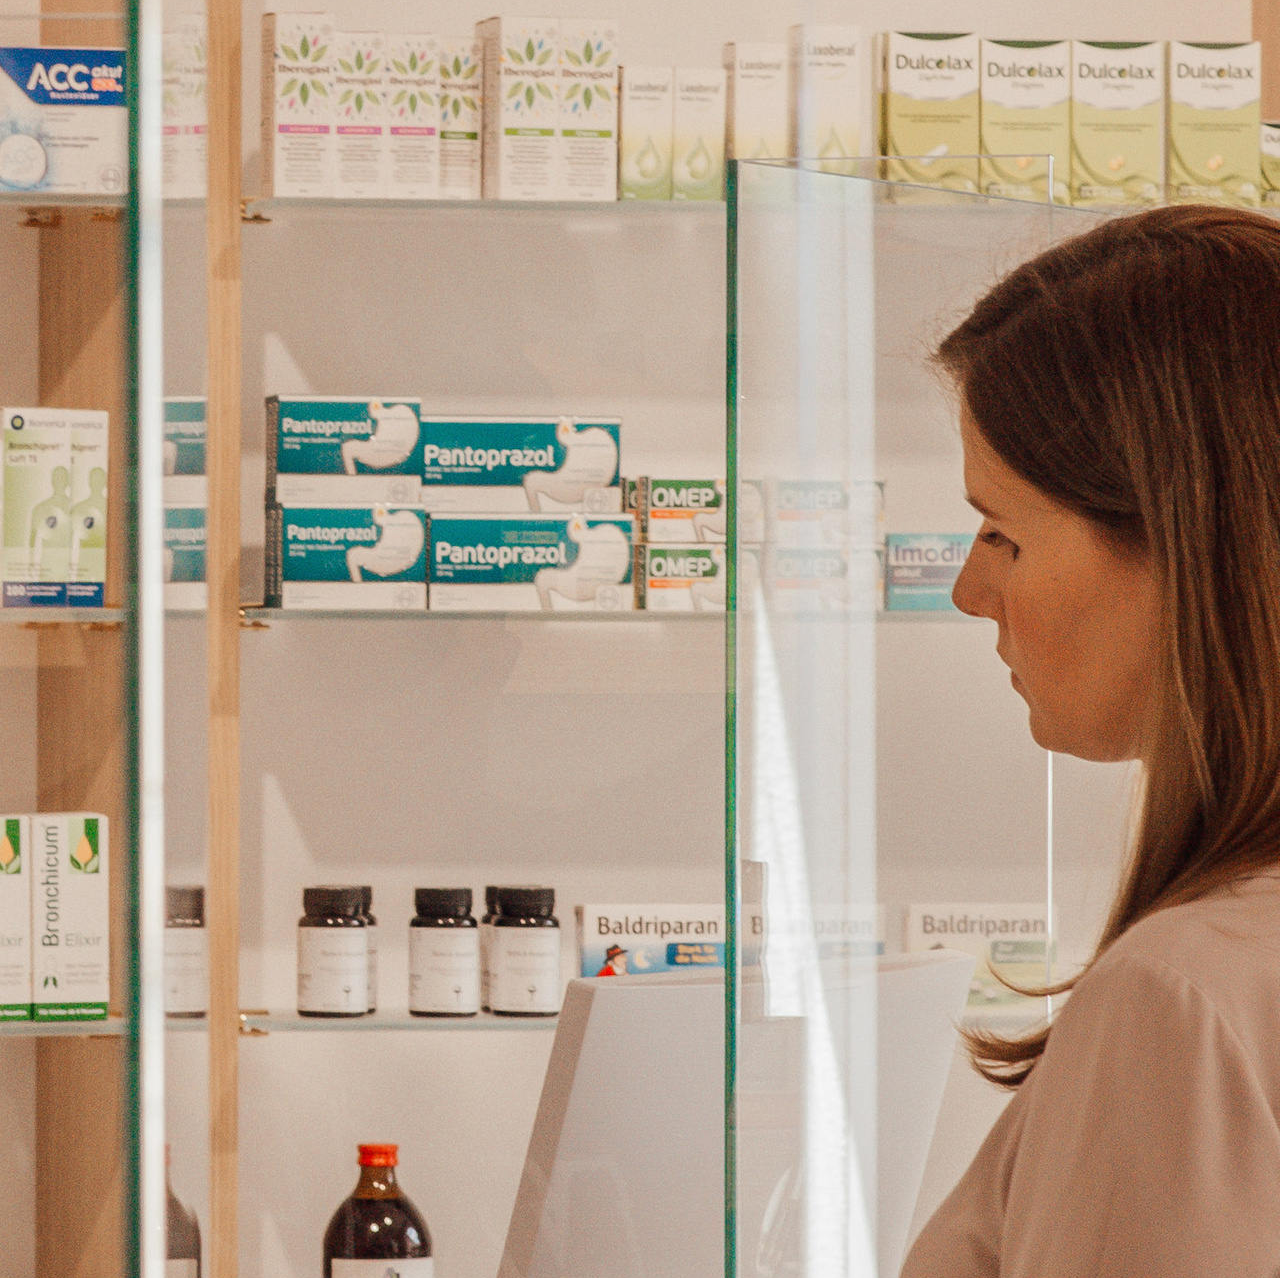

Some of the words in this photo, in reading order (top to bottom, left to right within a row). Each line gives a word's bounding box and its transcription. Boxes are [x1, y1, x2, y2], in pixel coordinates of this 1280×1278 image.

[278, 64, 330, 74] Iberogast
[895, 54, 974, 70] Dulcolax
[987, 62, 1064, 78] Dulcolax
[1078, 63, 1155, 79] Dulcolax
[1177, 63, 1254, 79] Dulcolax
[27, 64, 89, 92] ACC
[91, 65, 123, 79] akut
[282, 417, 373, 436] Pantoprazol
[424, 444, 555, 471] Pantoprazol
[652, 487, 715, 508] OMEP
[287, 524, 377, 543] Pantoprazol
[436, 541, 566, 568] Pantoprazol
[650, 557, 712, 577] OMEP
[41, 825, 59, 948] Bronchicum
[598, 916, 718, 938] Baldriparan
[922, 914, 1046, 939] Baldriparan
[65, 931, 102, 947] Elixir
